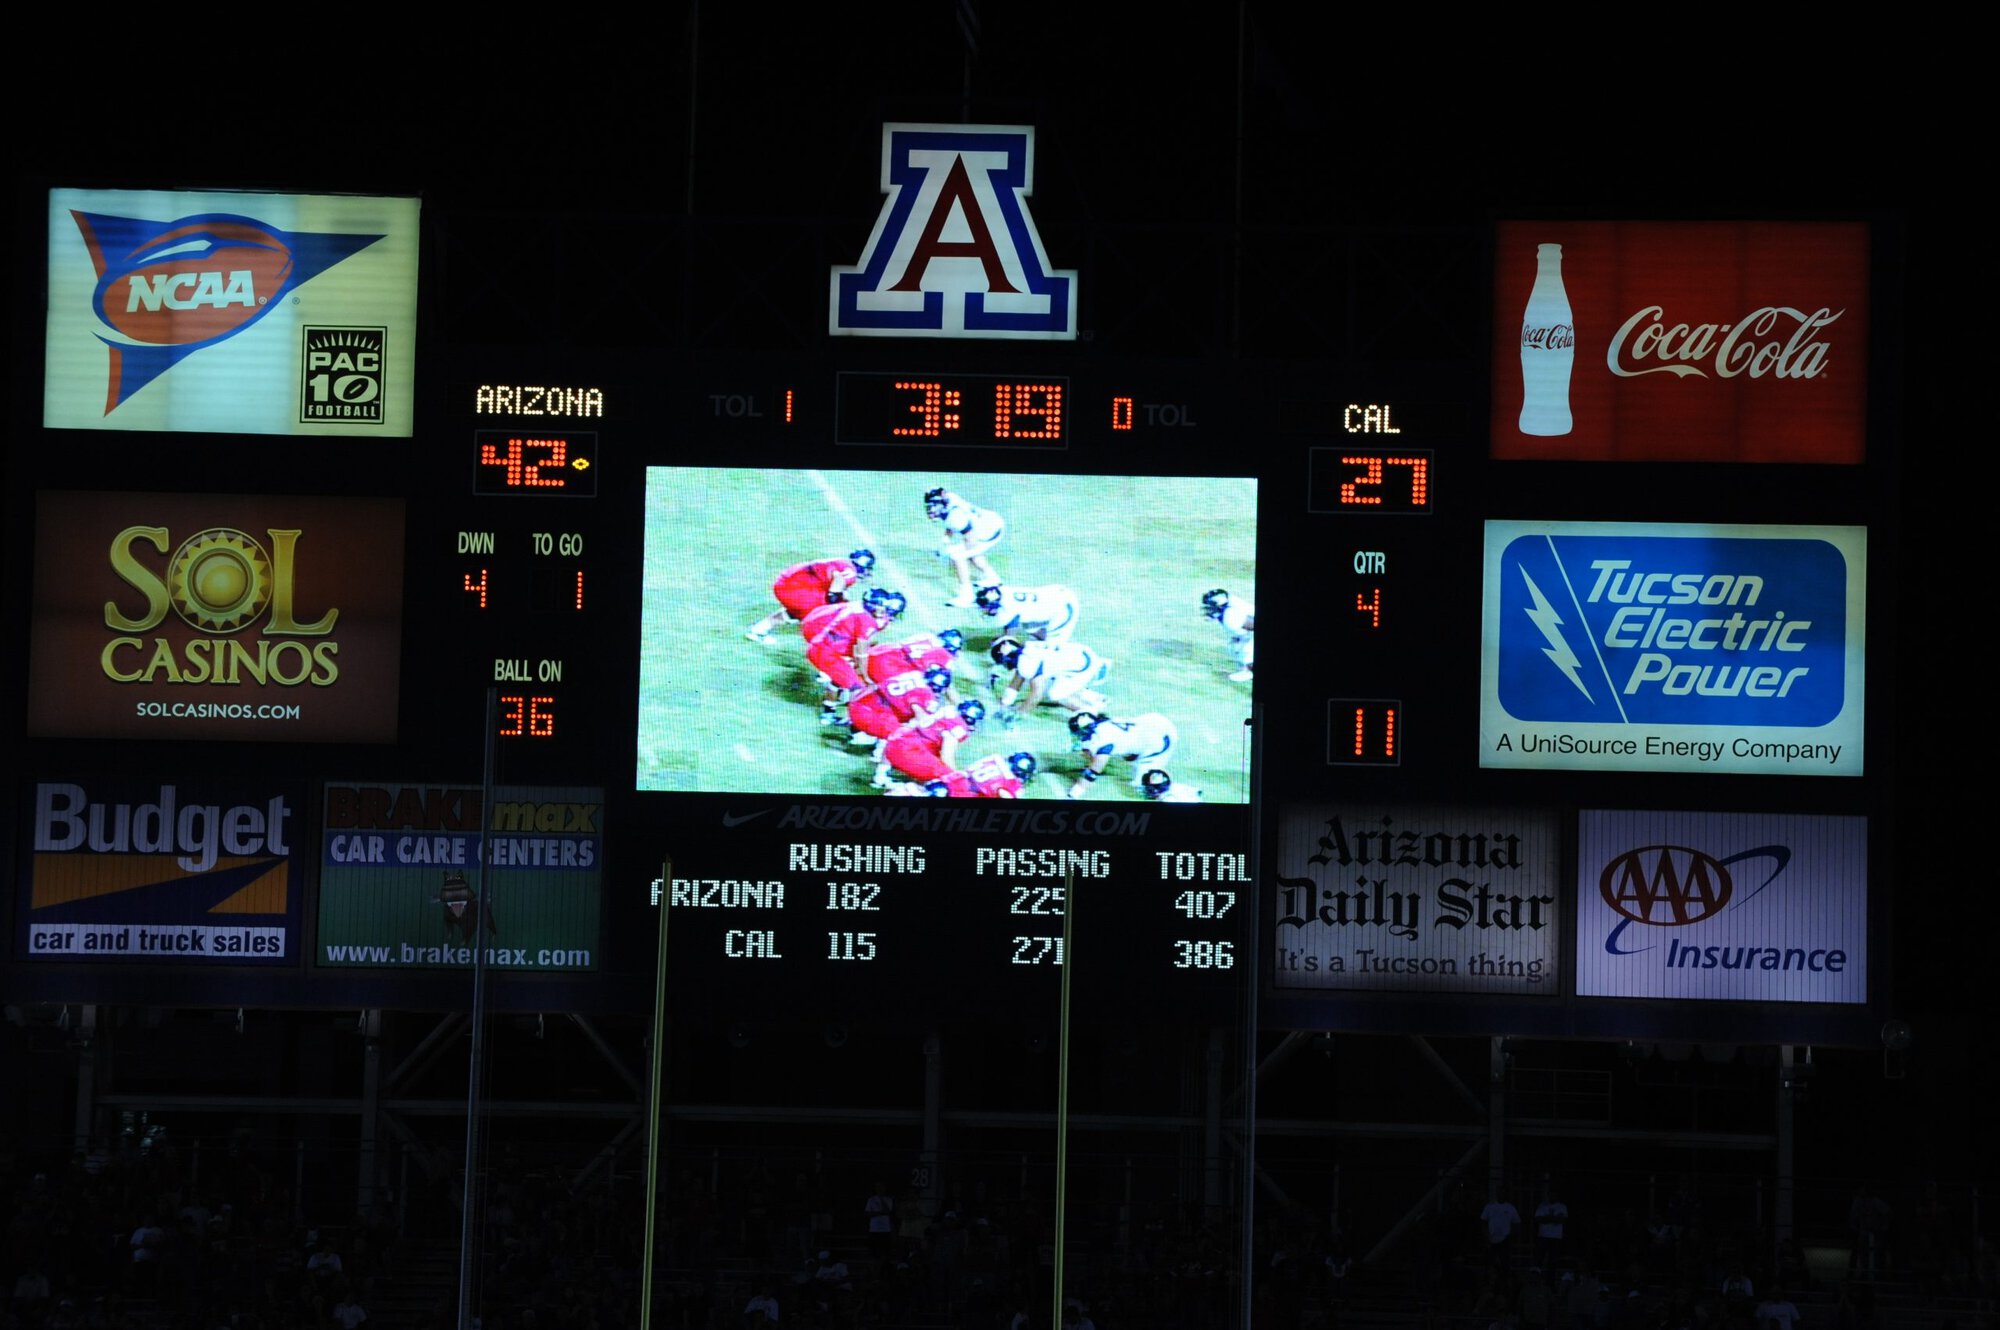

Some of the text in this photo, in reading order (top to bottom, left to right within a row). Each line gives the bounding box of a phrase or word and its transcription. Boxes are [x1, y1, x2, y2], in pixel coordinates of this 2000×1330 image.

[829, 122, 1078, 341] A
[126, 270, 255, 312] NCAA
[1606, 305, 1846, 379] Coca-Cola
[309, 352, 379, 372] PAC
[309, 374, 379, 403] 10
[476, 385, 603, 417] ARIZONA
[708, 395, 763, 417] TOL
[785, 390, 793, 424] 1
[308, 404, 377, 417] FOOTBALL
[1142, 404, 1196, 427] TOL
[1344, 404, 1401, 433] CAL
[481, 438, 567, 487] 42
[1341, 457, 1428, 505] 27
[457, 531, 495, 555] DWN
[532, 532, 584, 556] TO GO
[1353, 551, 1386, 574] QTR
[104, 525, 340, 636] SOL
[464, 567, 487, 609] 4
[576, 570, 584, 610] 1
[1587, 559, 1764, 606] Tucson
[1356, 587, 1380, 629] 4
[1604, 606, 1812, 652] Electric
[100, 637, 340, 687] CASINOS
[494, 658, 562, 682] BALL ON
[1623, 653, 1809, 698] Power
[136, 702, 300, 720] SOLCASINOS.COM
[499, 696, 555, 737] 36
[1354, 707, 1396, 758] 11
[1496, 733, 1842, 764] A UniSource Energy Company
[34, 782, 291, 872] Budget
[776, 804, 1151, 836] ARIZONAATHLETICS.COM
[330, 834, 385, 864] CAR
[396, 836, 466, 865] CARE
[788, 843, 1252, 881] RUSHING PASSING TOTAL
[1307, 815, 1523, 870] Arizona
[650, 878, 1236, 919] ARIZONA 182 225 407
[1614, 847, 1720, 924] AAA
[1275, 873, 1555, 941] Daily Star
[34, 929, 280, 953] car and truck sales
[725, 929, 1234, 969] CAL 115 271 386
[1666, 938, 1847, 972] Insurance
[1278, 948, 1551, 983] It's a Tucson thing.
[911, 1167, 929, 1188] 28
